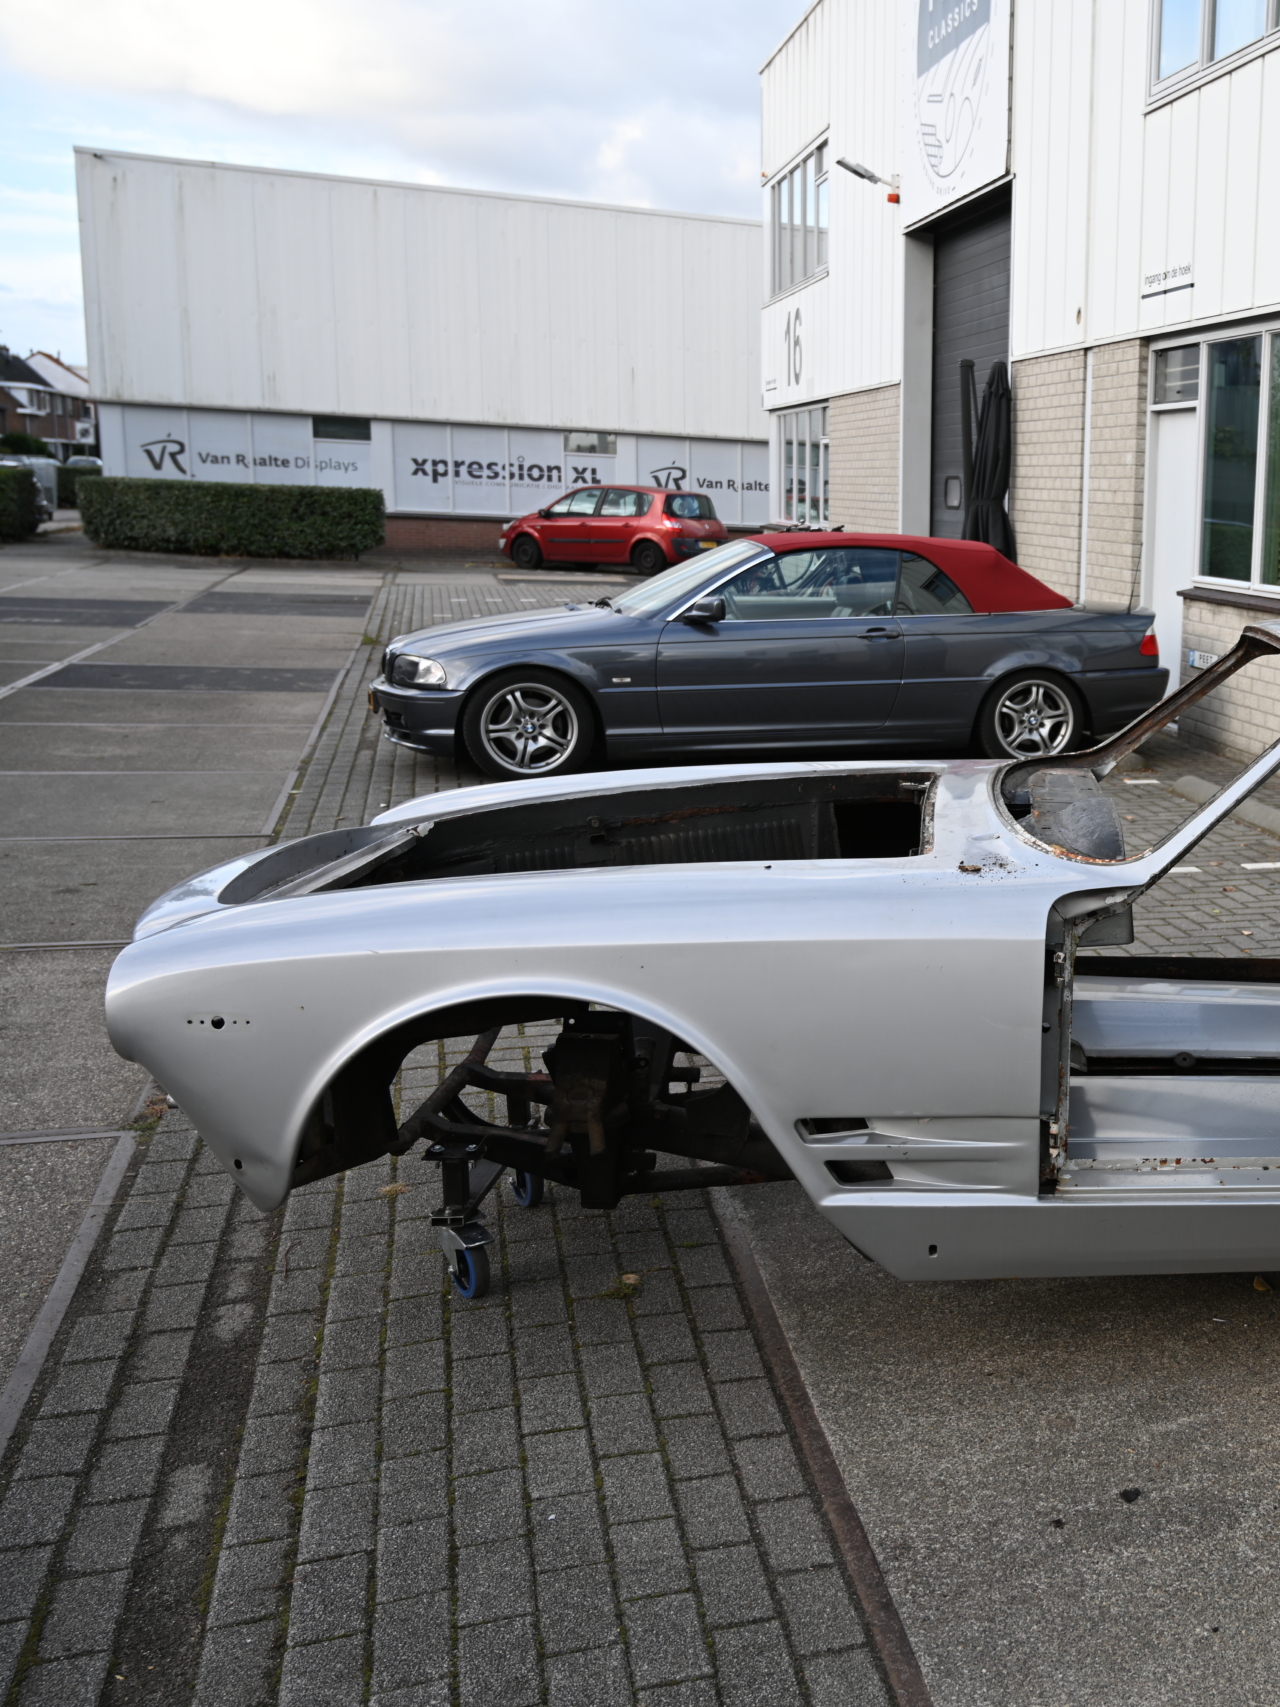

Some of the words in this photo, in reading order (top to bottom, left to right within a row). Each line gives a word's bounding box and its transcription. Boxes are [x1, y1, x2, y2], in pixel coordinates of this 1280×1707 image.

[928, 0, 978, 49] CLASSICS
[784, 307, 803, 387] 16
[198, 452, 231, 466] Van
[410, 455, 562, 484] xpression
[696, 478, 723, 490] Van
